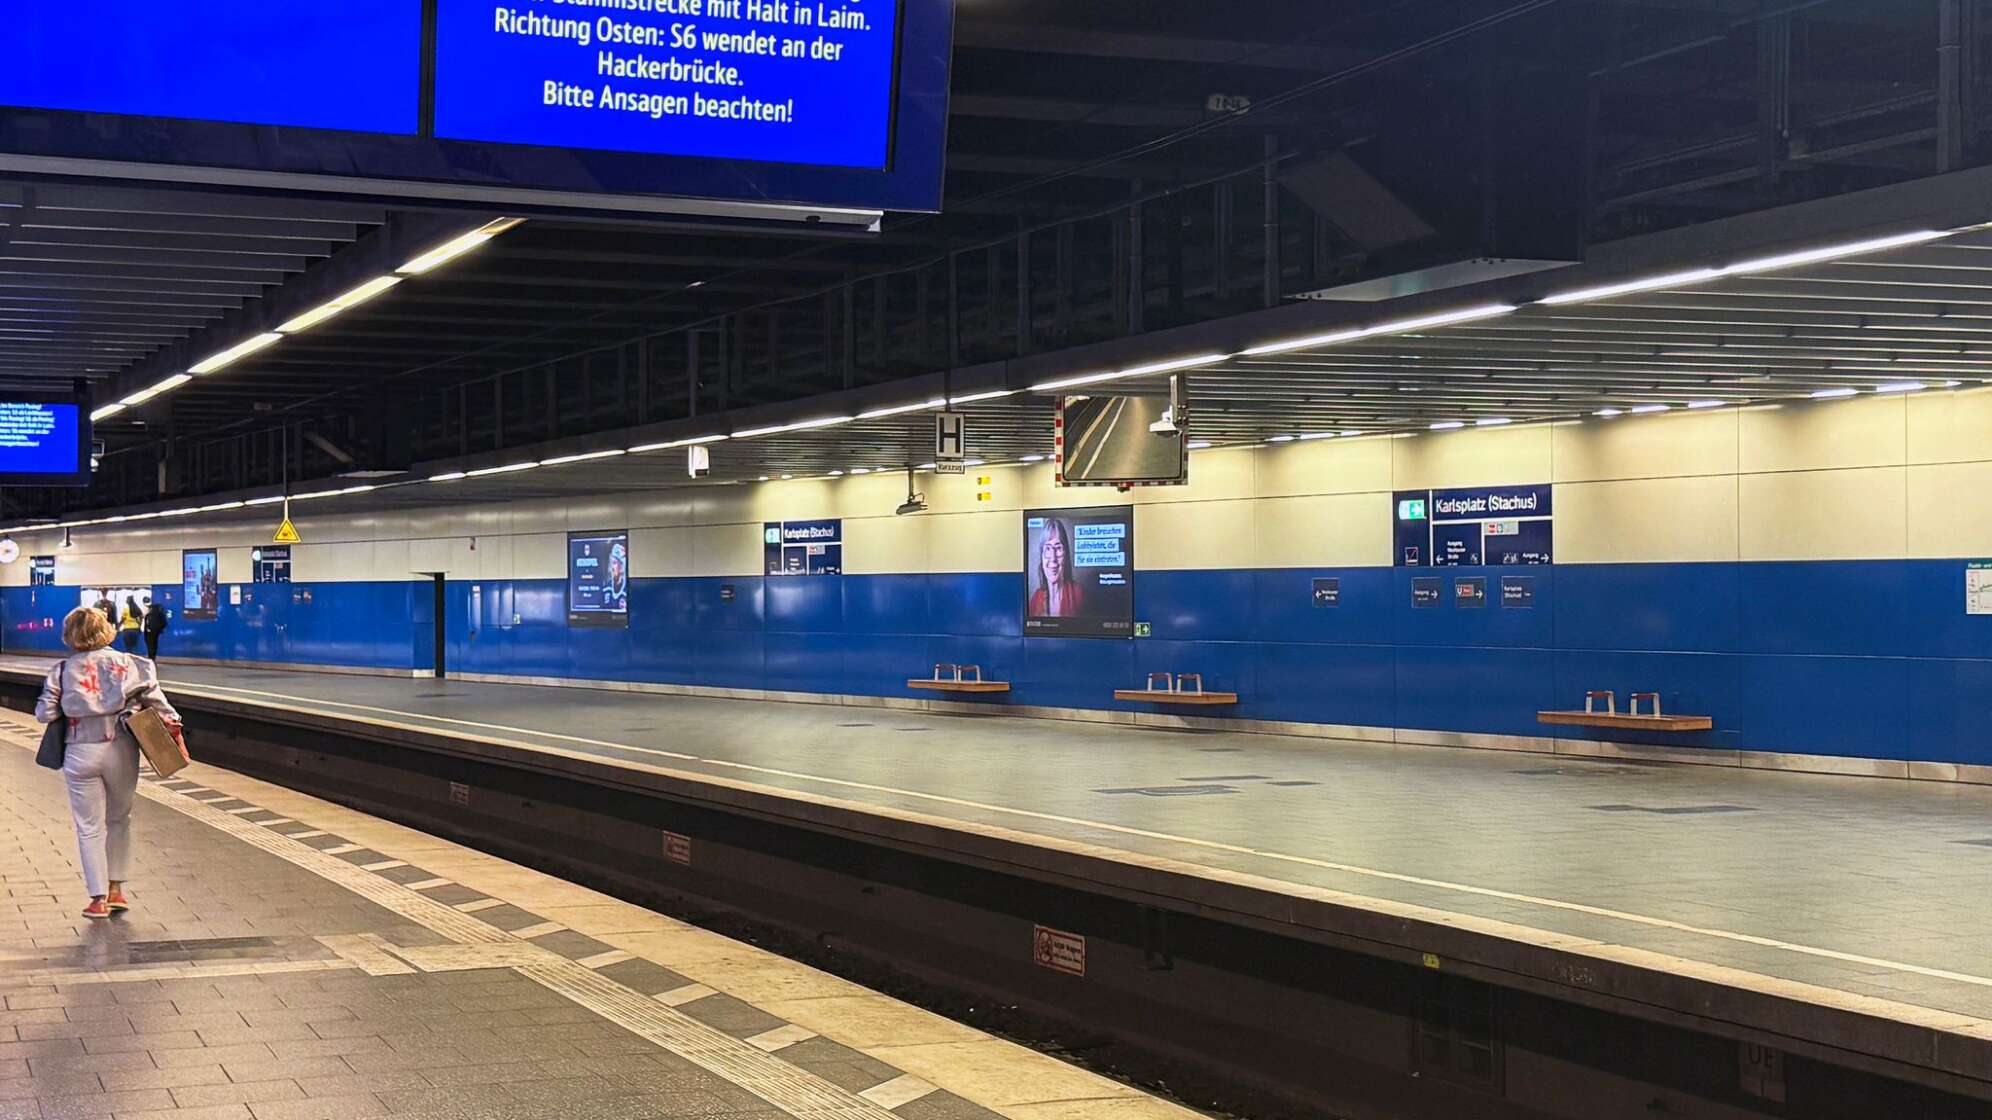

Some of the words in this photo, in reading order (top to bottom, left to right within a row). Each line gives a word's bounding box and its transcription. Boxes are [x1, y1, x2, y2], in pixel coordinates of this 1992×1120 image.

[707, 0, 741, 19] mit
[746, 0, 788, 24] Halt
[794, 1, 811, 25] in
[817, 2, 871, 31] Laim.
[494, 8, 591, 46] Richtung
[596, 17, 665, 47] Osten:
[670, 23, 696, 50] S6
[702, 30, 776, 56] wendet
[781, 38, 806, 58] an
[810, 36, 843, 61] der
[597, 51, 744, 86] Hackerbrücke.
[543, 80, 594, 108] Bitte
[599, 86, 689, 119] Ansagen
[693, 92, 793, 123] beachten!
[939, 417, 961, 453] H
[1435, 497, 1486, 514] Karlsplatz
[1488, 492, 1537, 512] (Stachus)
